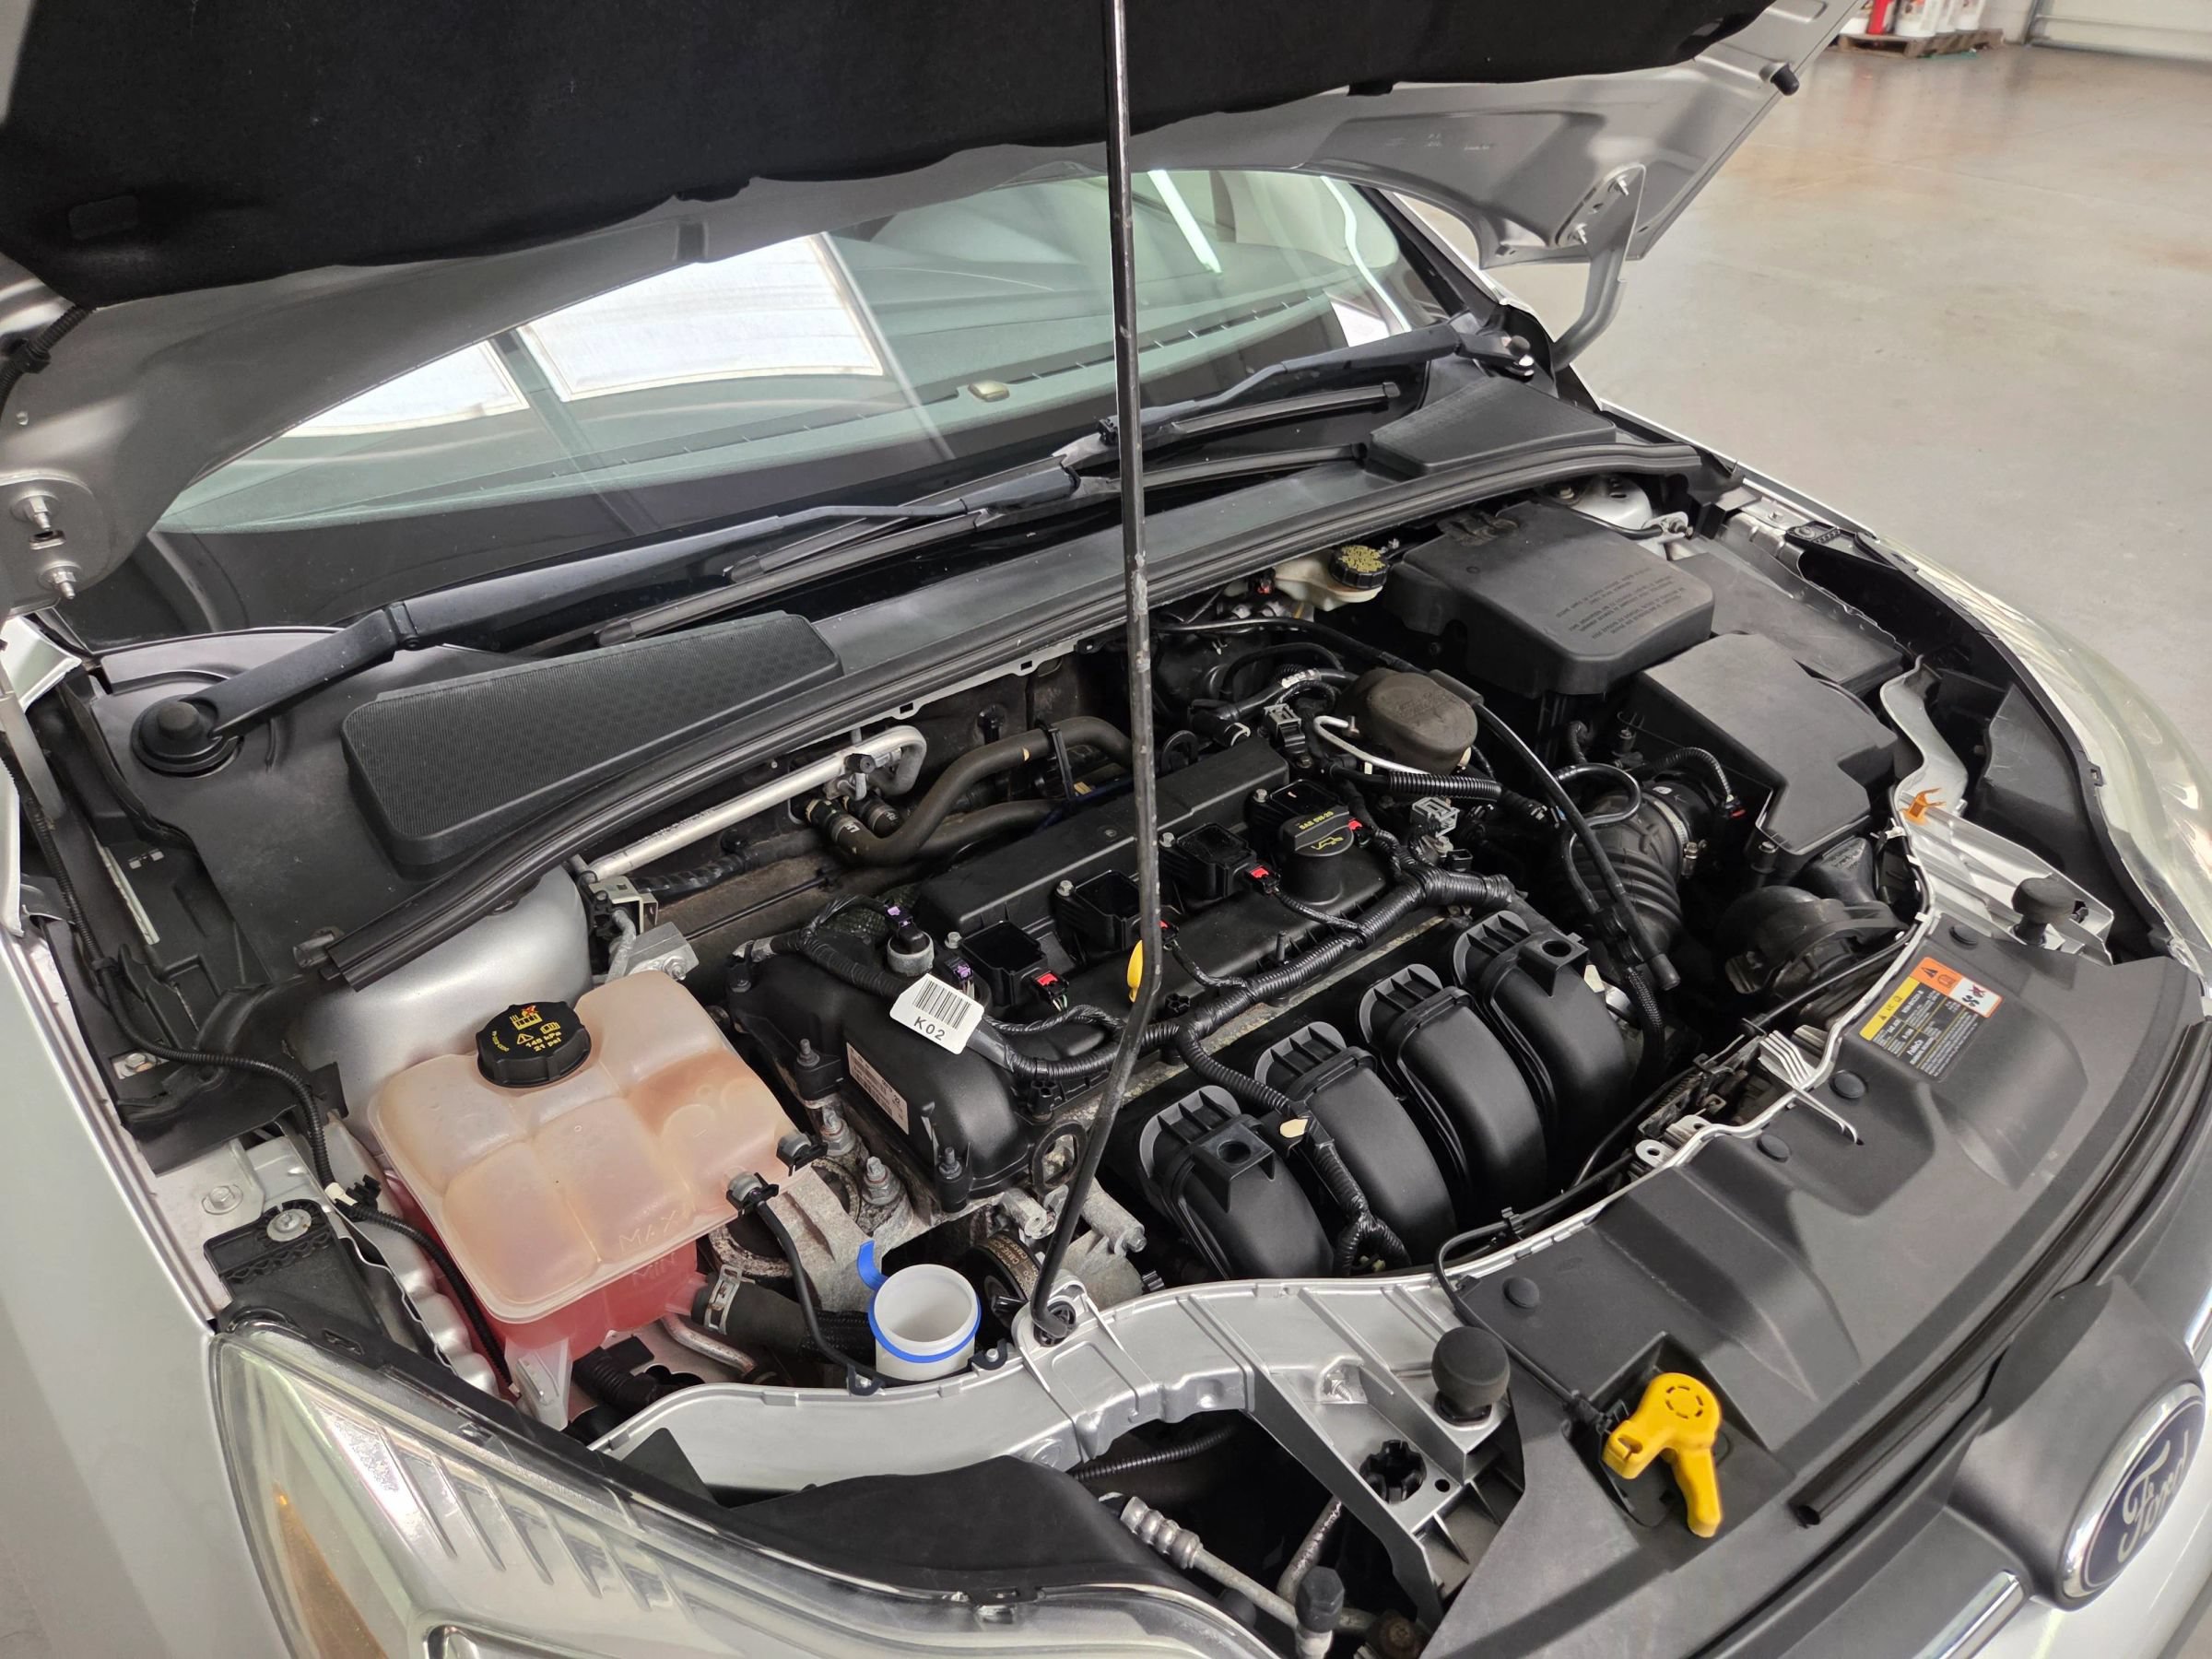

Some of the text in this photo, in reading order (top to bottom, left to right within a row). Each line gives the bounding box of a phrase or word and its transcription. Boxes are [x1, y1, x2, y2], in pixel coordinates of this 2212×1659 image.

[543, 1031, 562, 1041] kPa
[913, 1016, 947, 1041] K02
[534, 1037, 562, 1053] 21 psi
[618, 1209, 678, 1254] MAX
[632, 1252, 678, 1287] MIN
[2117, 1430, 2190, 1565] Ford
